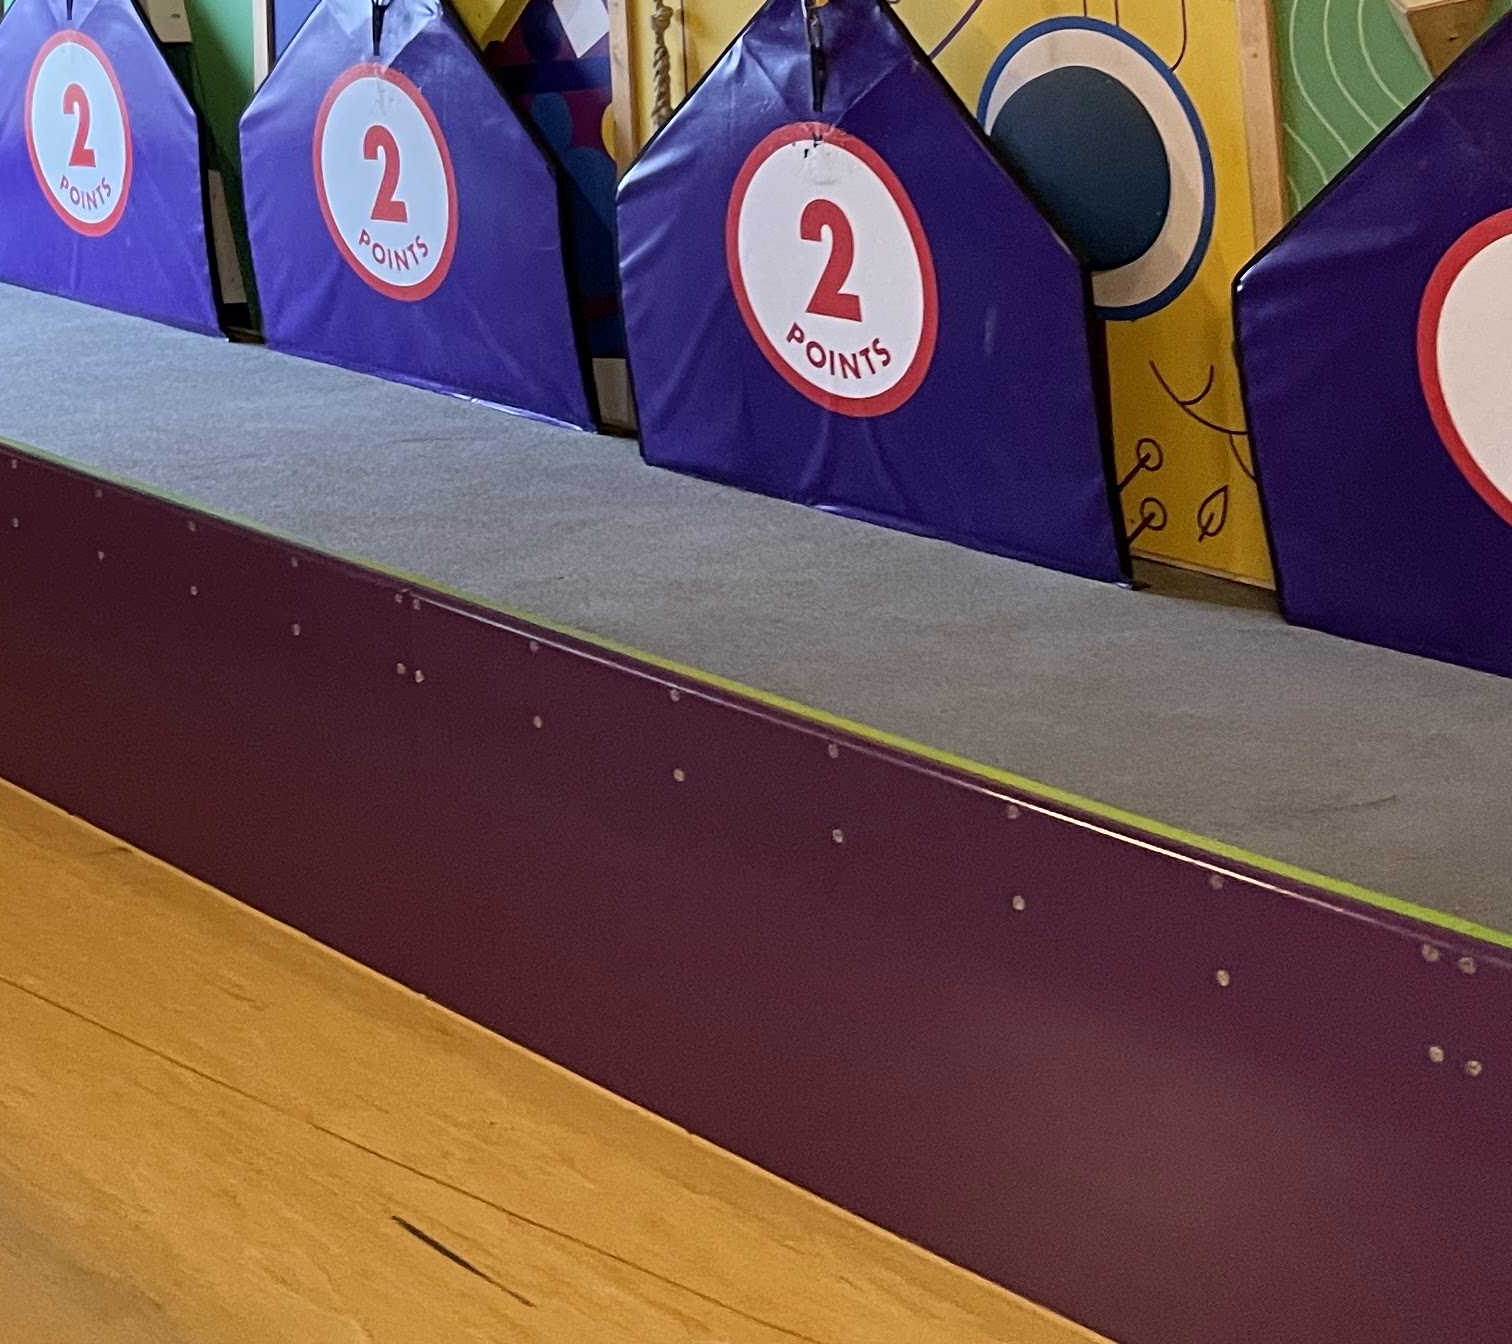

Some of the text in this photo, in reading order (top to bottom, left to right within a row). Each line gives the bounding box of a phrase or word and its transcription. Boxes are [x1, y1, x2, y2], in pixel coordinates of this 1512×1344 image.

[63, 83, 97, 168] 2
[59, 174, 113, 212] POINTS
[363, 124, 408, 223] 2
[358, 229, 429, 272] POINTS
[799, 198, 863, 322] 2
[786, 322, 892, 380] POINTS
